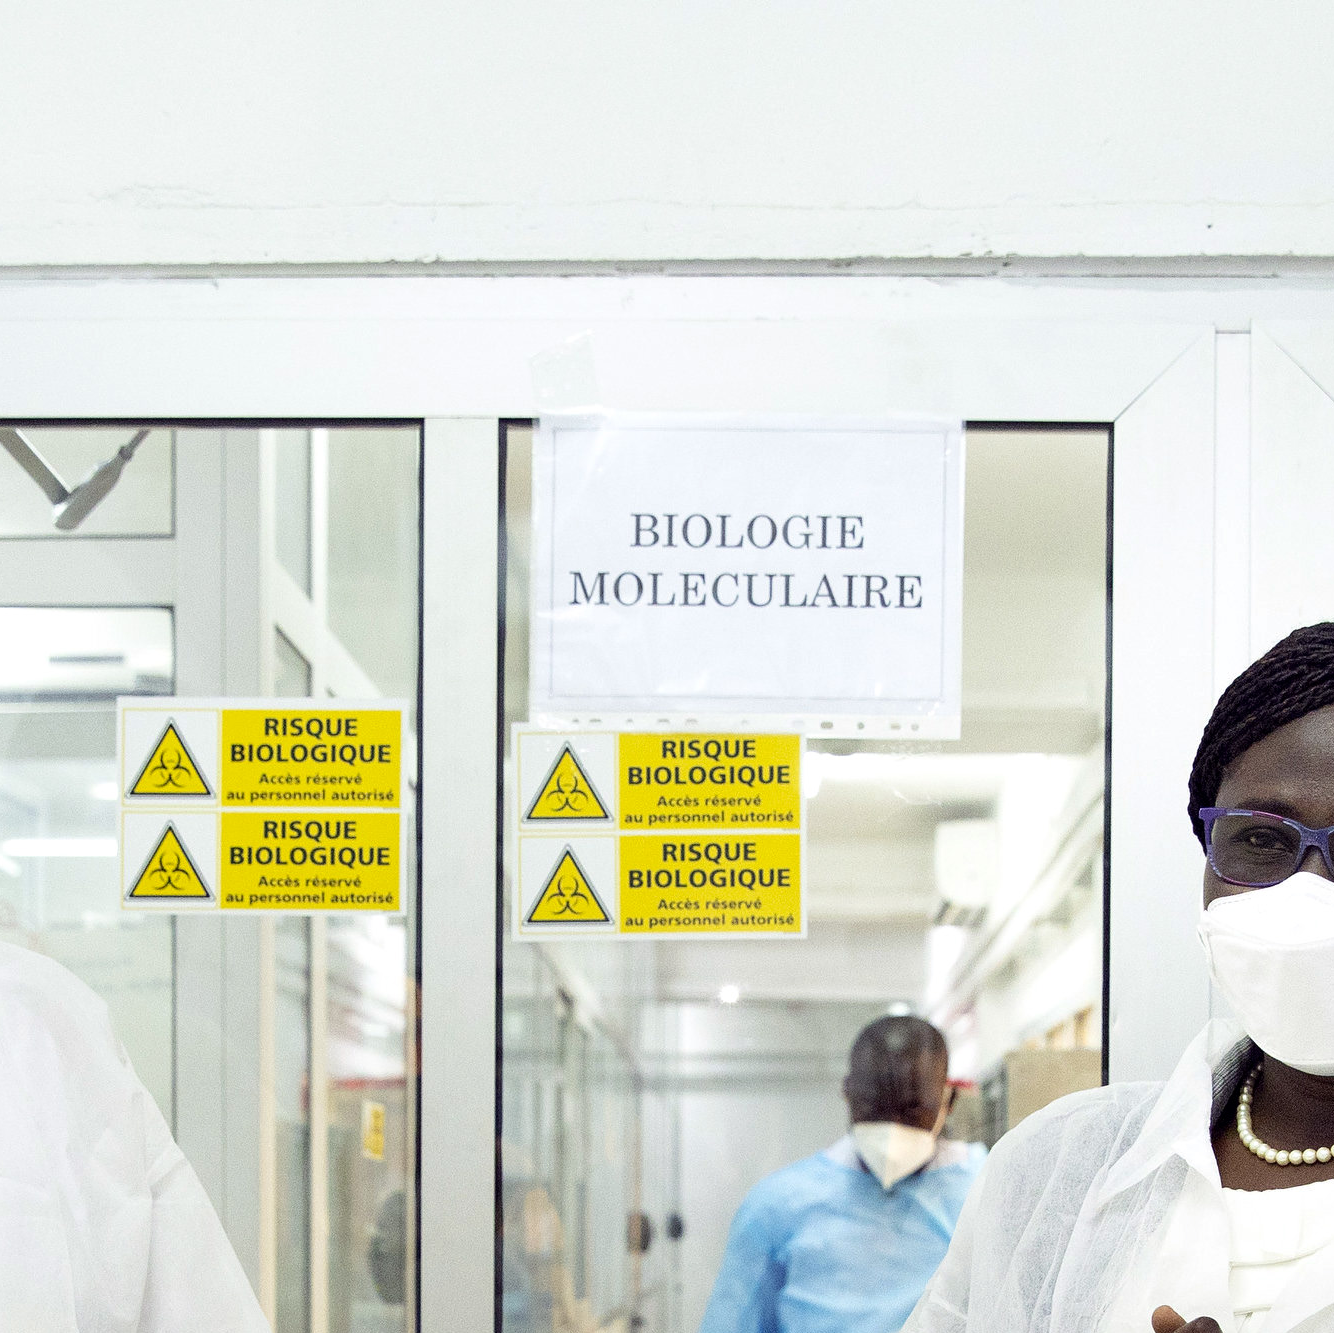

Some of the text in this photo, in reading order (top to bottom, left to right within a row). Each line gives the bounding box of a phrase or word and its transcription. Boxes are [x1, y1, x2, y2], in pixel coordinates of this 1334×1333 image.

[630, 513, 864, 550] BIOLOGIE
[569, 571, 923, 609] MOLECULAIRE
[264, 718, 357, 739] RISQUE
[230, 743, 391, 766] BIOLOGIQUE
[662, 739, 756, 761] RISQUE
[259, 773, 362, 784] Accès réservé
[628, 765, 790, 787] BIOLOGIQUE
[227, 789, 394, 803] au personnel autorisé
[657, 794, 761, 806] Accès réservé
[624, 810, 793, 825] au personnel autorisé
[264, 820, 357, 841] RISQUE
[230, 846, 390, 868] BIOLOGIQUE
[662, 842, 756, 864] RISQUE
[258, 876, 361, 887] Accès réservé
[628, 868, 790, 891] BIOLOGIQUE
[226, 892, 393, 905] au personnel autorisé
[658, 897, 762, 910] Accès réservé
[626, 913, 794, 929] au personnel autorisé
